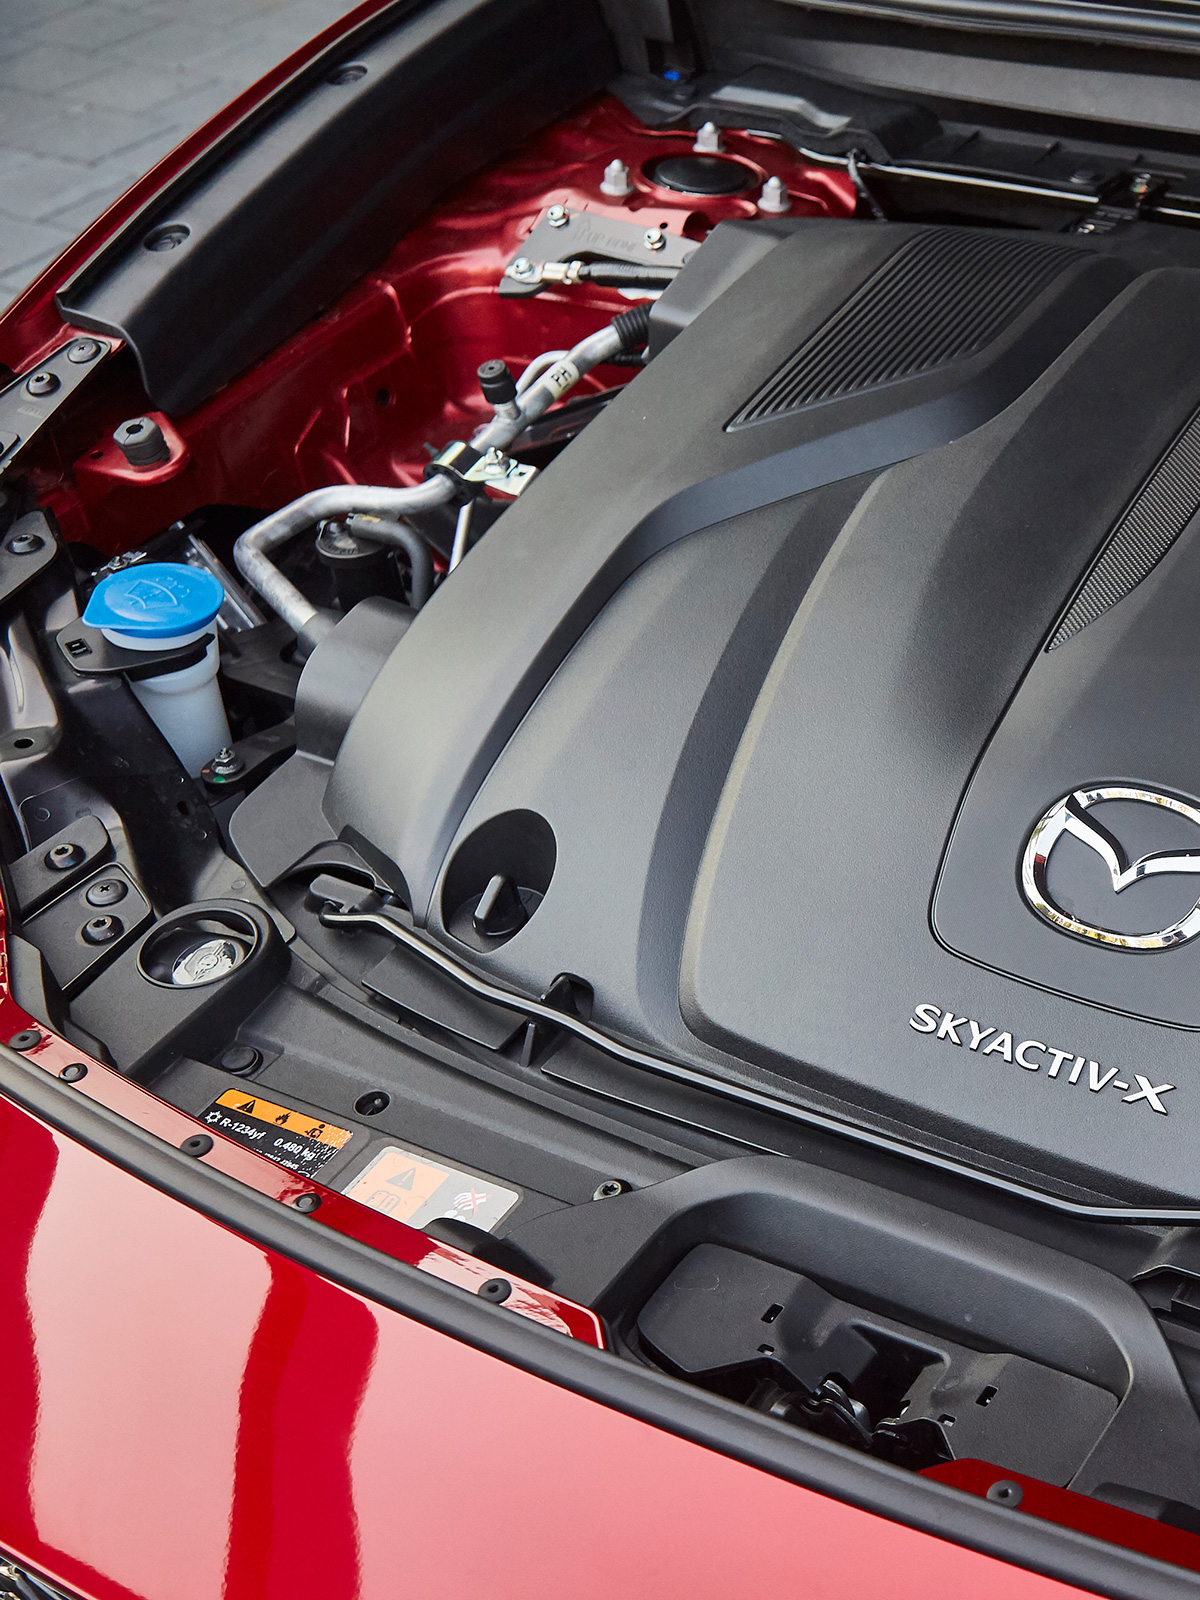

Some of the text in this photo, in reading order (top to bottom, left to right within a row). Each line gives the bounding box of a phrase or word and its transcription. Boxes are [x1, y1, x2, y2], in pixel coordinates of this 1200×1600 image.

[909, 1003, 1176, 1115] SKYACTIV-X
[219, 1117, 267, 1140] R-1234yf
[273, 1138, 302, 1156] 0.480
